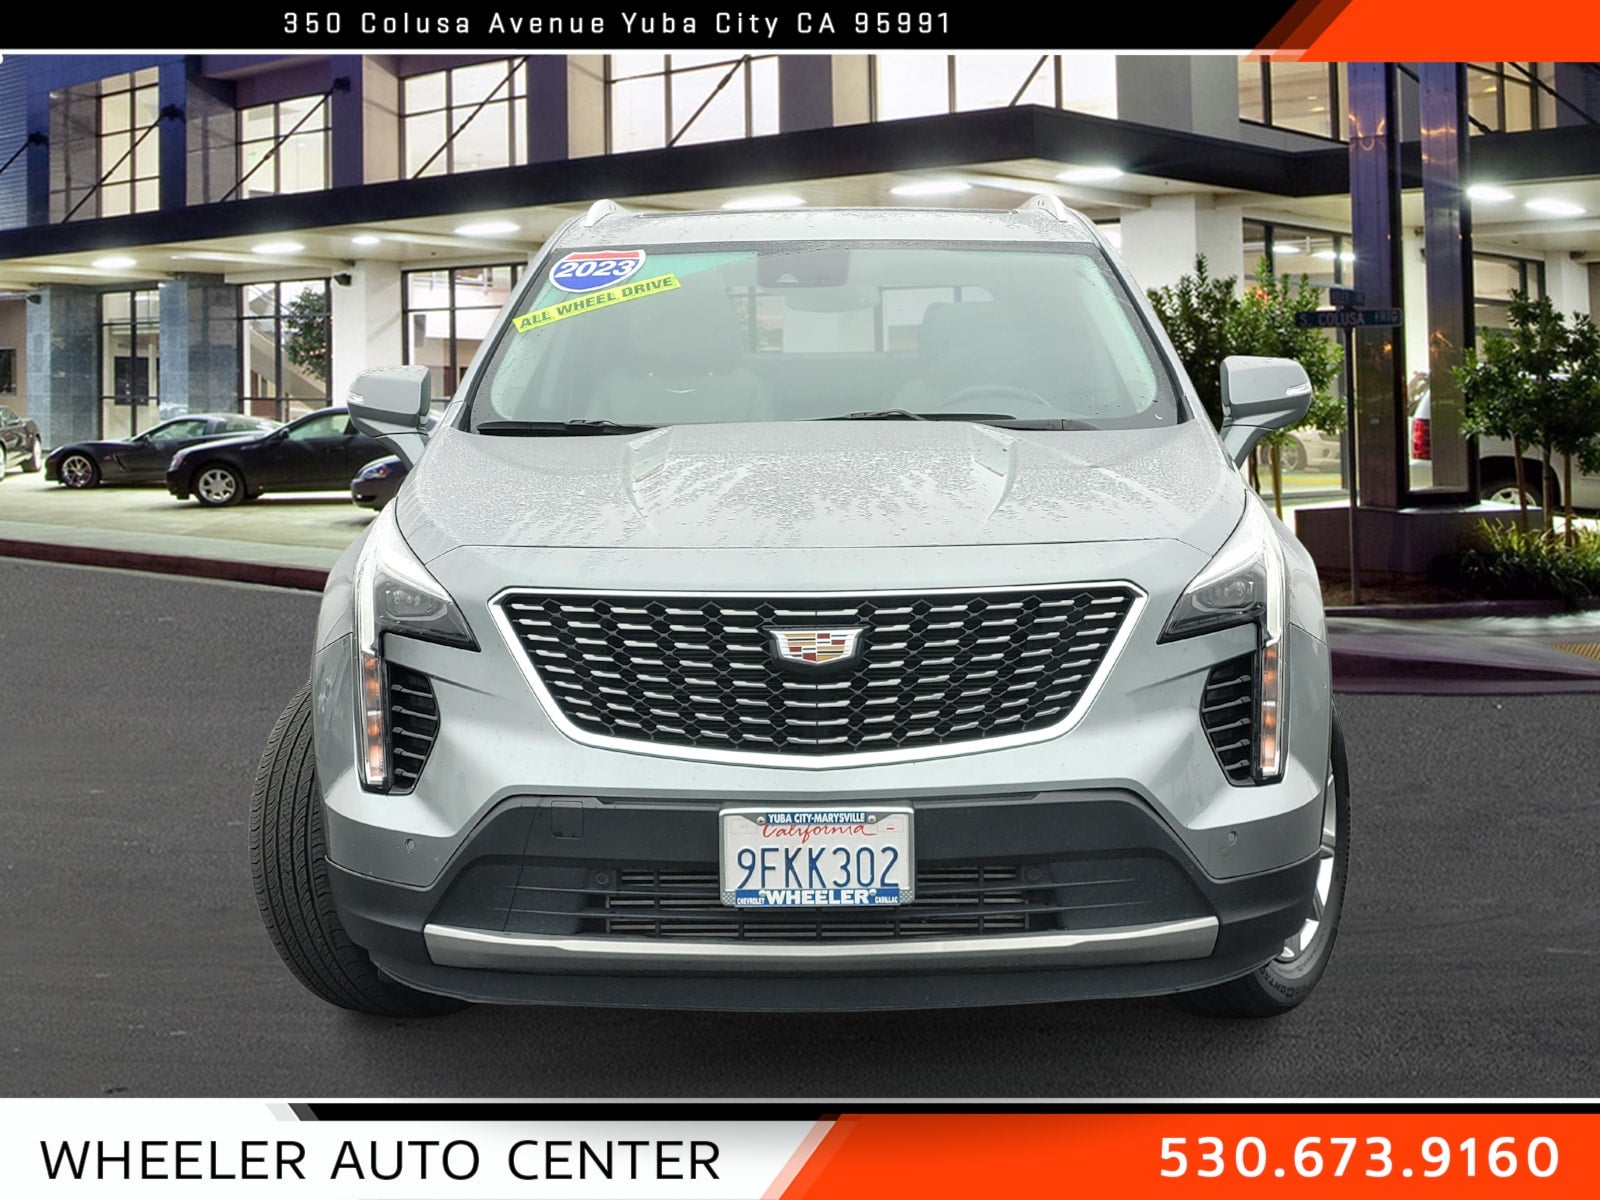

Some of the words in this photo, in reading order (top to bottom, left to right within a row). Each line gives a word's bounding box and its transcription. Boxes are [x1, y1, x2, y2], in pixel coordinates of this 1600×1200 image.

[554, 259, 634, 278] 2023
[519, 311, 552, 330] ALL
[556, 291, 617, 315] WHEEL
[621, 276, 675, 298] DRIVE
[1318, 312, 1366, 326] COLUSA
[767, 813, 792, 824] YUBA
[762, 824, 877, 843] California
[736, 846, 900, 889] 9FKK302
[736, 896, 766, 906] CHEVROLET
[765, 889, 870, 905] WHEELER
[874, 896, 898, 904] CADILLAC
